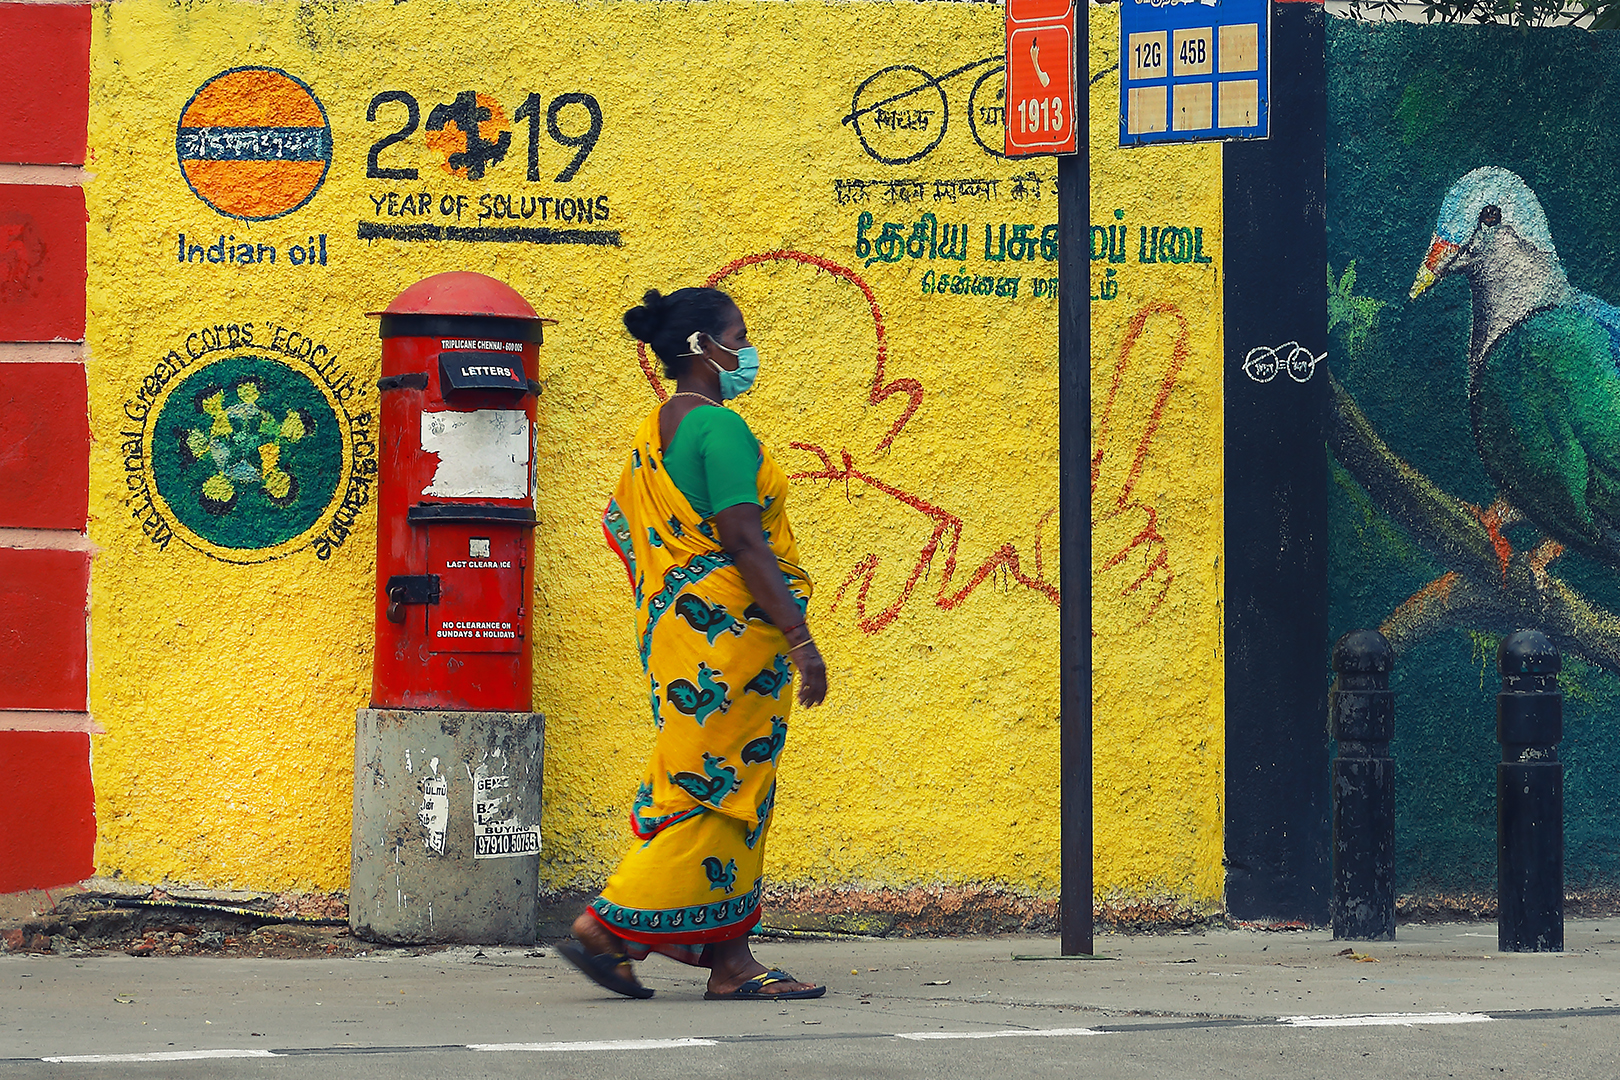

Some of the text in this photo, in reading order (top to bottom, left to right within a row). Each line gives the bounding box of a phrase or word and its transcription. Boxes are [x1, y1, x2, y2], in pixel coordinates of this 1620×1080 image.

[1135, 42, 1161, 69] 12G
[1179, 38, 1206, 65] 45B
[1018, 97, 1063, 133] 1913
[366, 90, 604, 182] 2019
[369, 192, 610, 225] YEAR OF SOLUTIONS
[177, 233, 328, 267] Indian oil
[441, 340, 477, 349] TRIPLICANE
[477, 340, 503, 351] CHENNAI
[461, 366, 512, 377] LETTERS
[436, 630, 515, 639] SUNDAYS & HOLIDAYS
[442, 621, 511, 630] NO CLEARANCE ON
[478, 834, 510, 854] 97910
